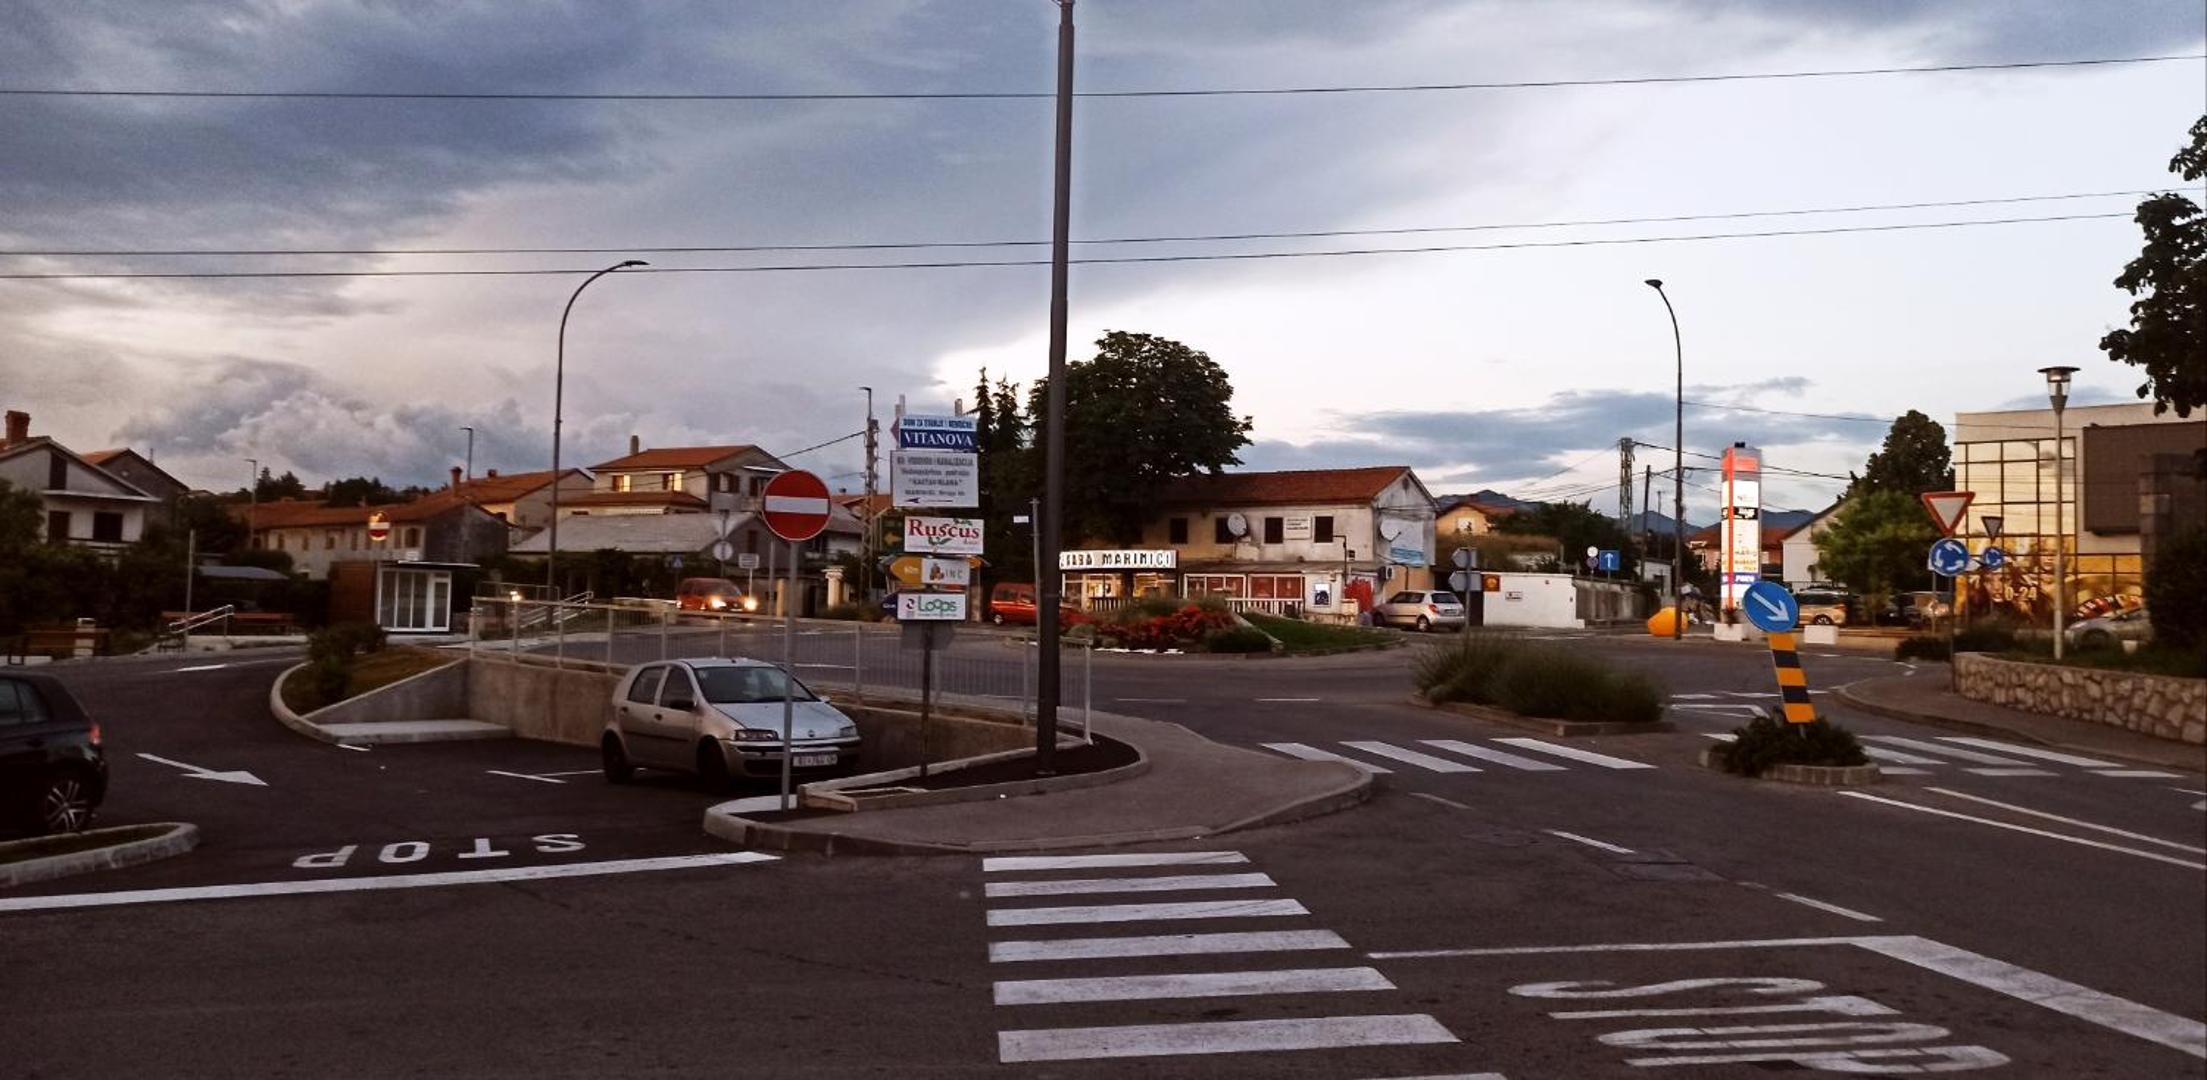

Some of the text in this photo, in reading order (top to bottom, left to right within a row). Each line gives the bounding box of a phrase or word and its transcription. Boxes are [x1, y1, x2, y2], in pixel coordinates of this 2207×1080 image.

[904, 431, 973, 446] VITANOVA
[908, 518, 980, 538] Ruscus
[918, 595, 957, 615] Loops
[292, 833, 587, 868] STOP
[1507, 976, 2010, 1073] STOP
